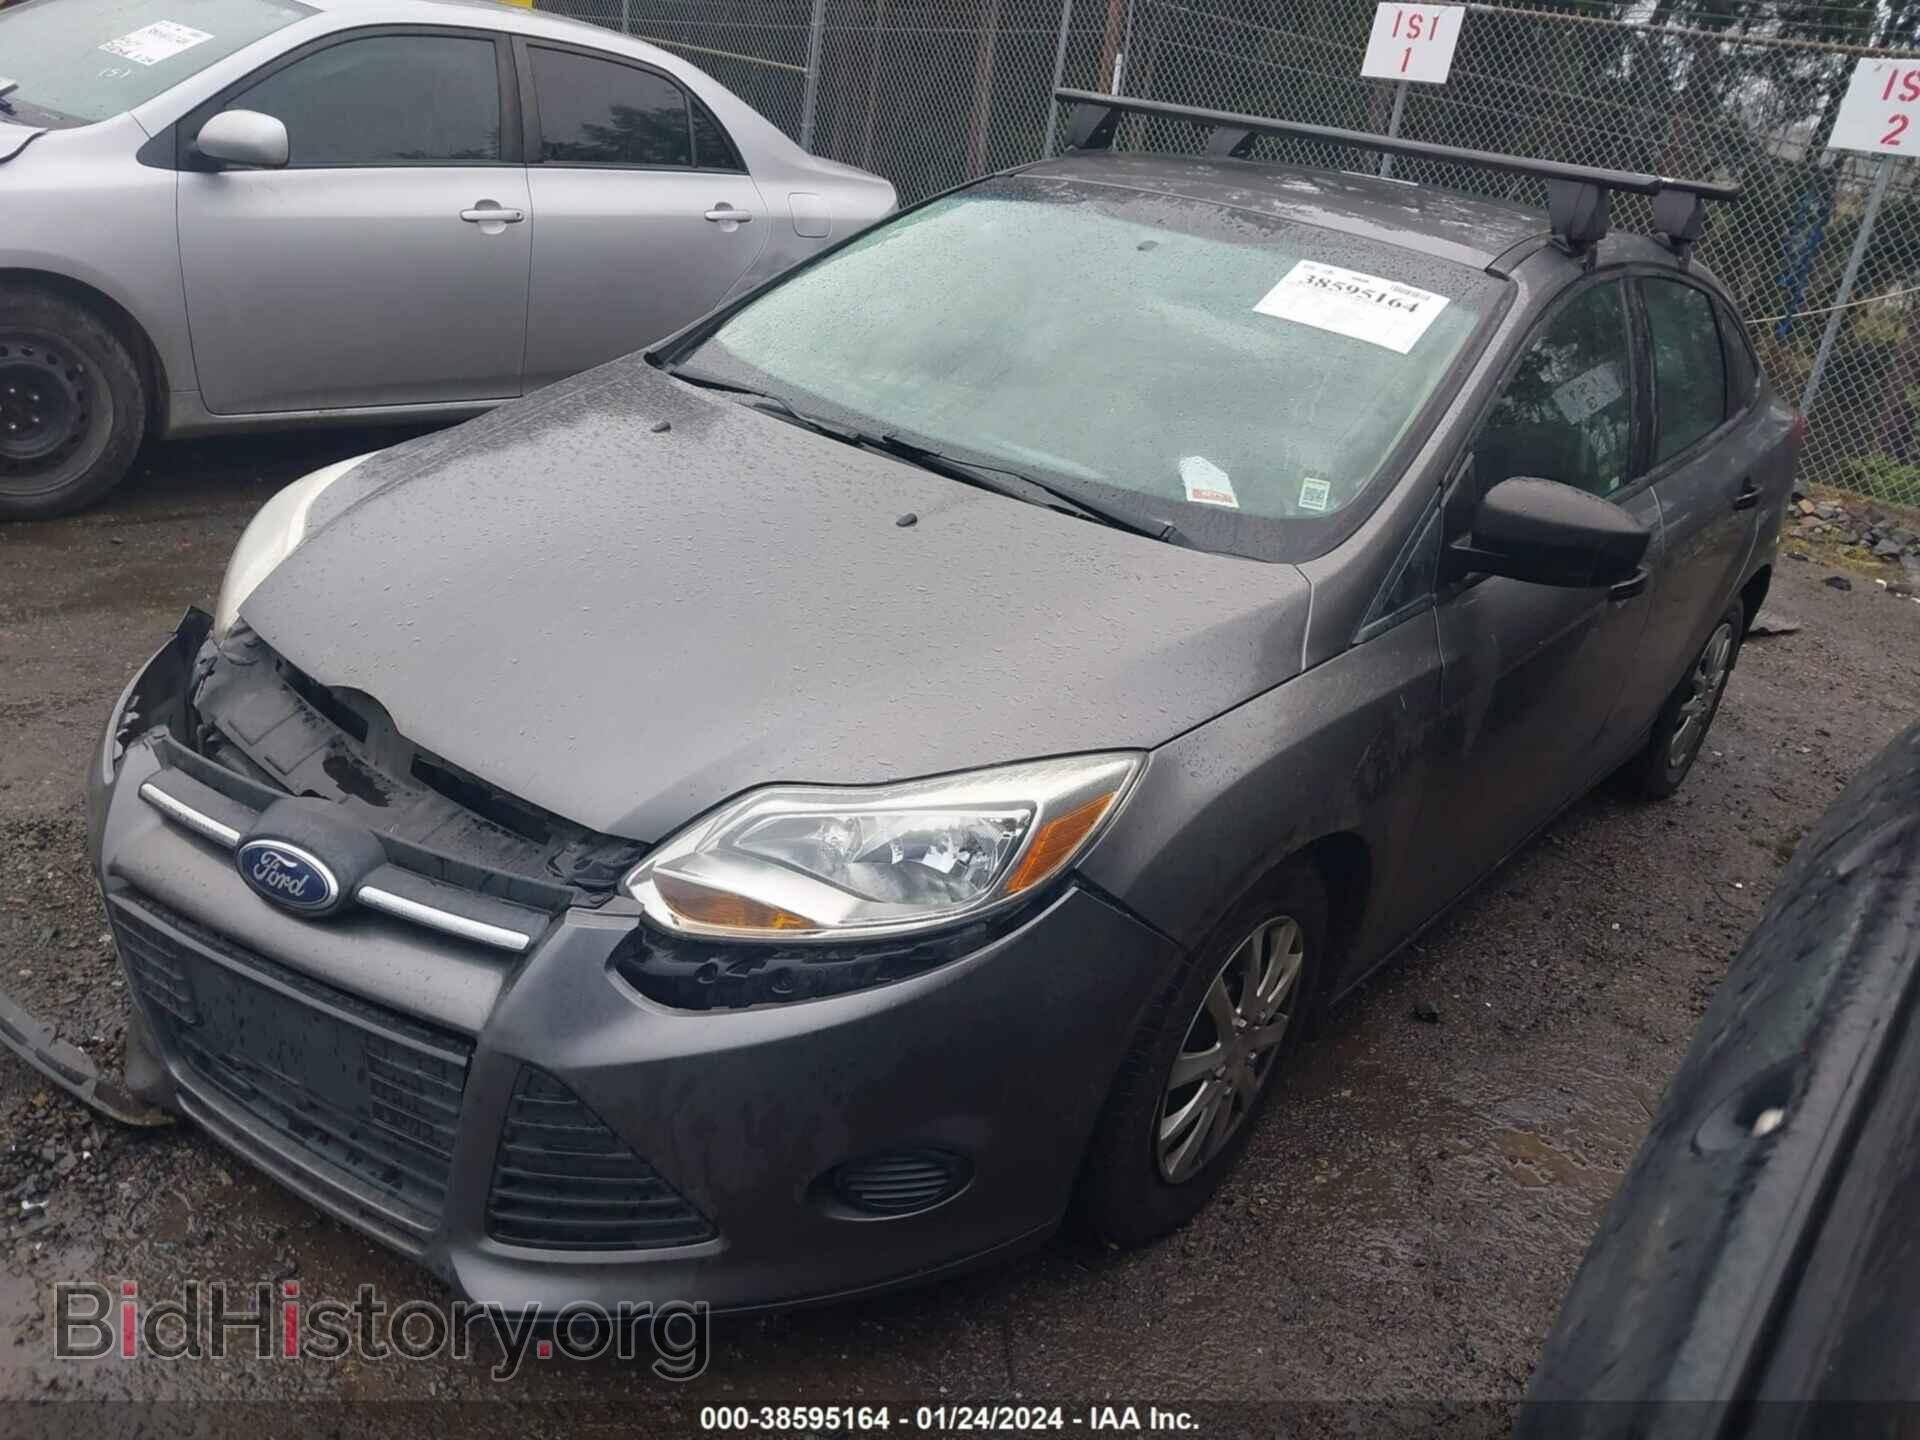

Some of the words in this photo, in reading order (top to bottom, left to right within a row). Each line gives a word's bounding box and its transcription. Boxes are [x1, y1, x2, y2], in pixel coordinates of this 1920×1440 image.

[1879, 113, 1910, 146] 2
[1306, 273, 1420, 313] 38595164
[253, 850, 310, 896] Ford
